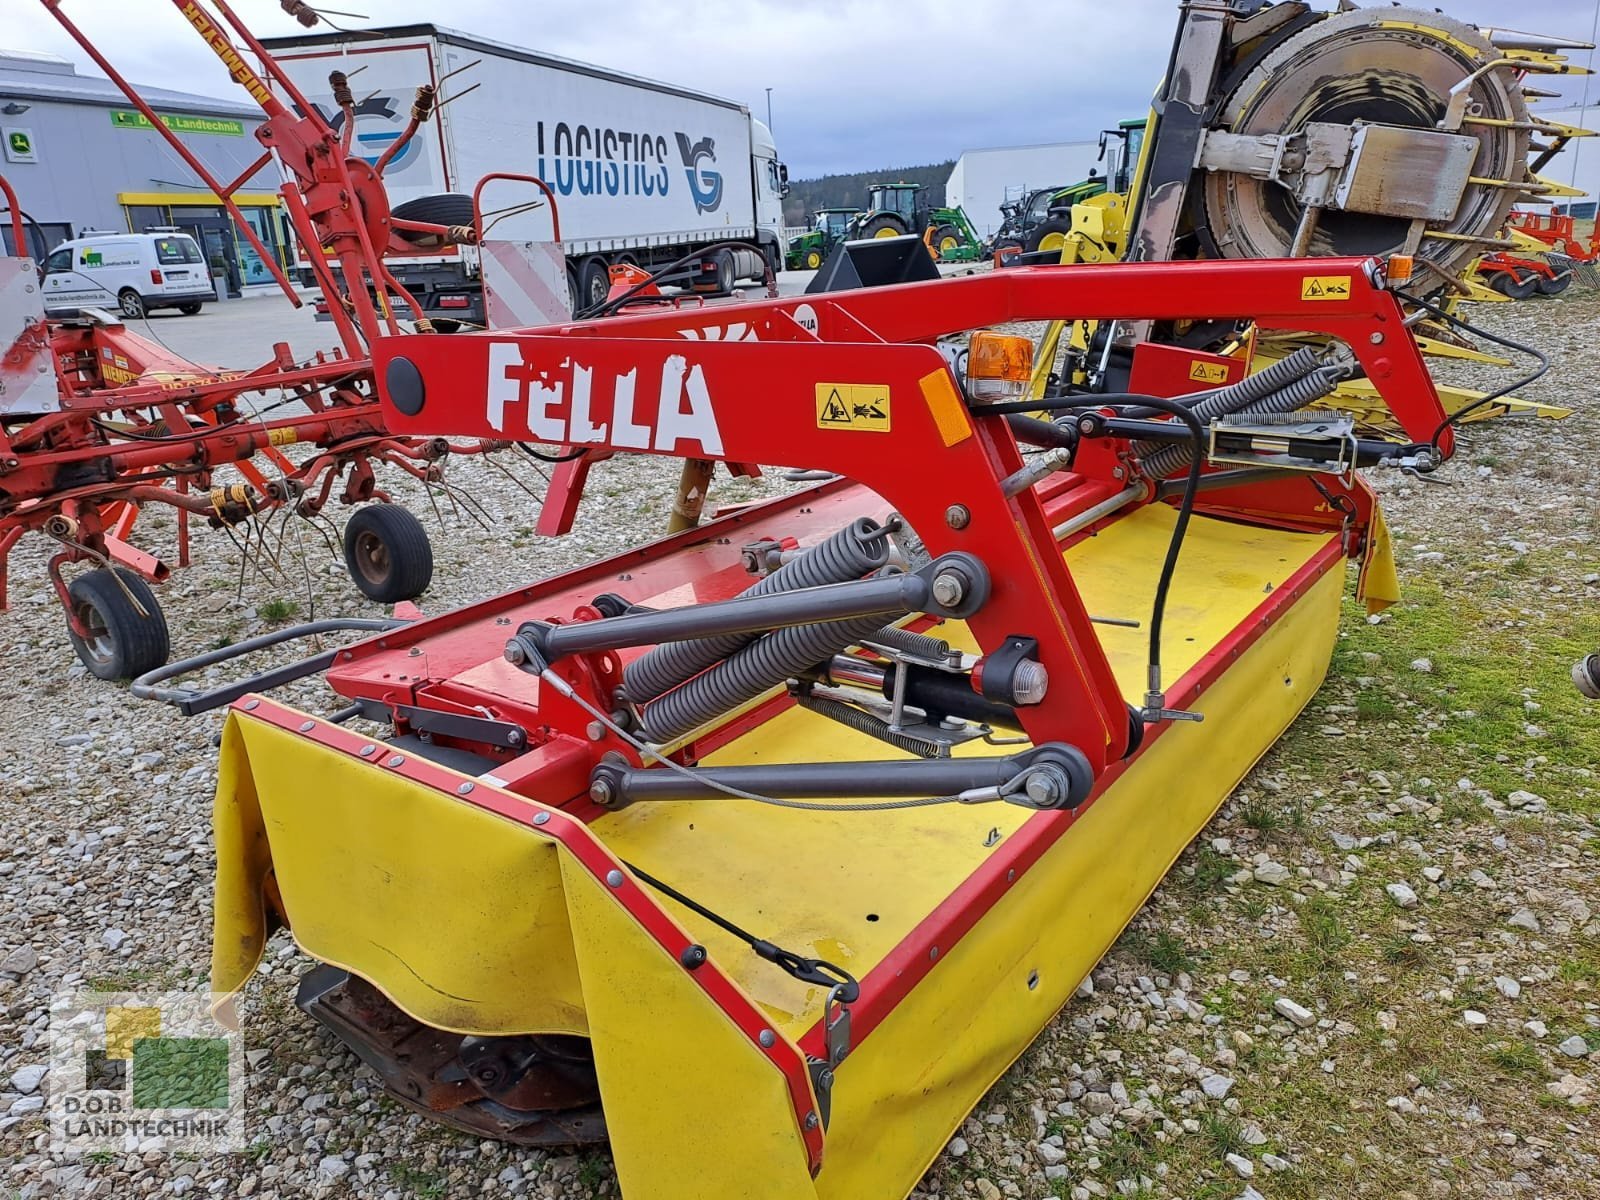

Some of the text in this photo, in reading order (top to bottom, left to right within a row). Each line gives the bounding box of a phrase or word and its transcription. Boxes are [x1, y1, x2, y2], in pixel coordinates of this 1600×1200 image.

[183, 2, 271, 105] NIEMEYER
[176, 118, 239, 132] Landtechnik
[537, 121, 669, 197] LOGISTICS
[486, 342, 725, 456] FELLA
